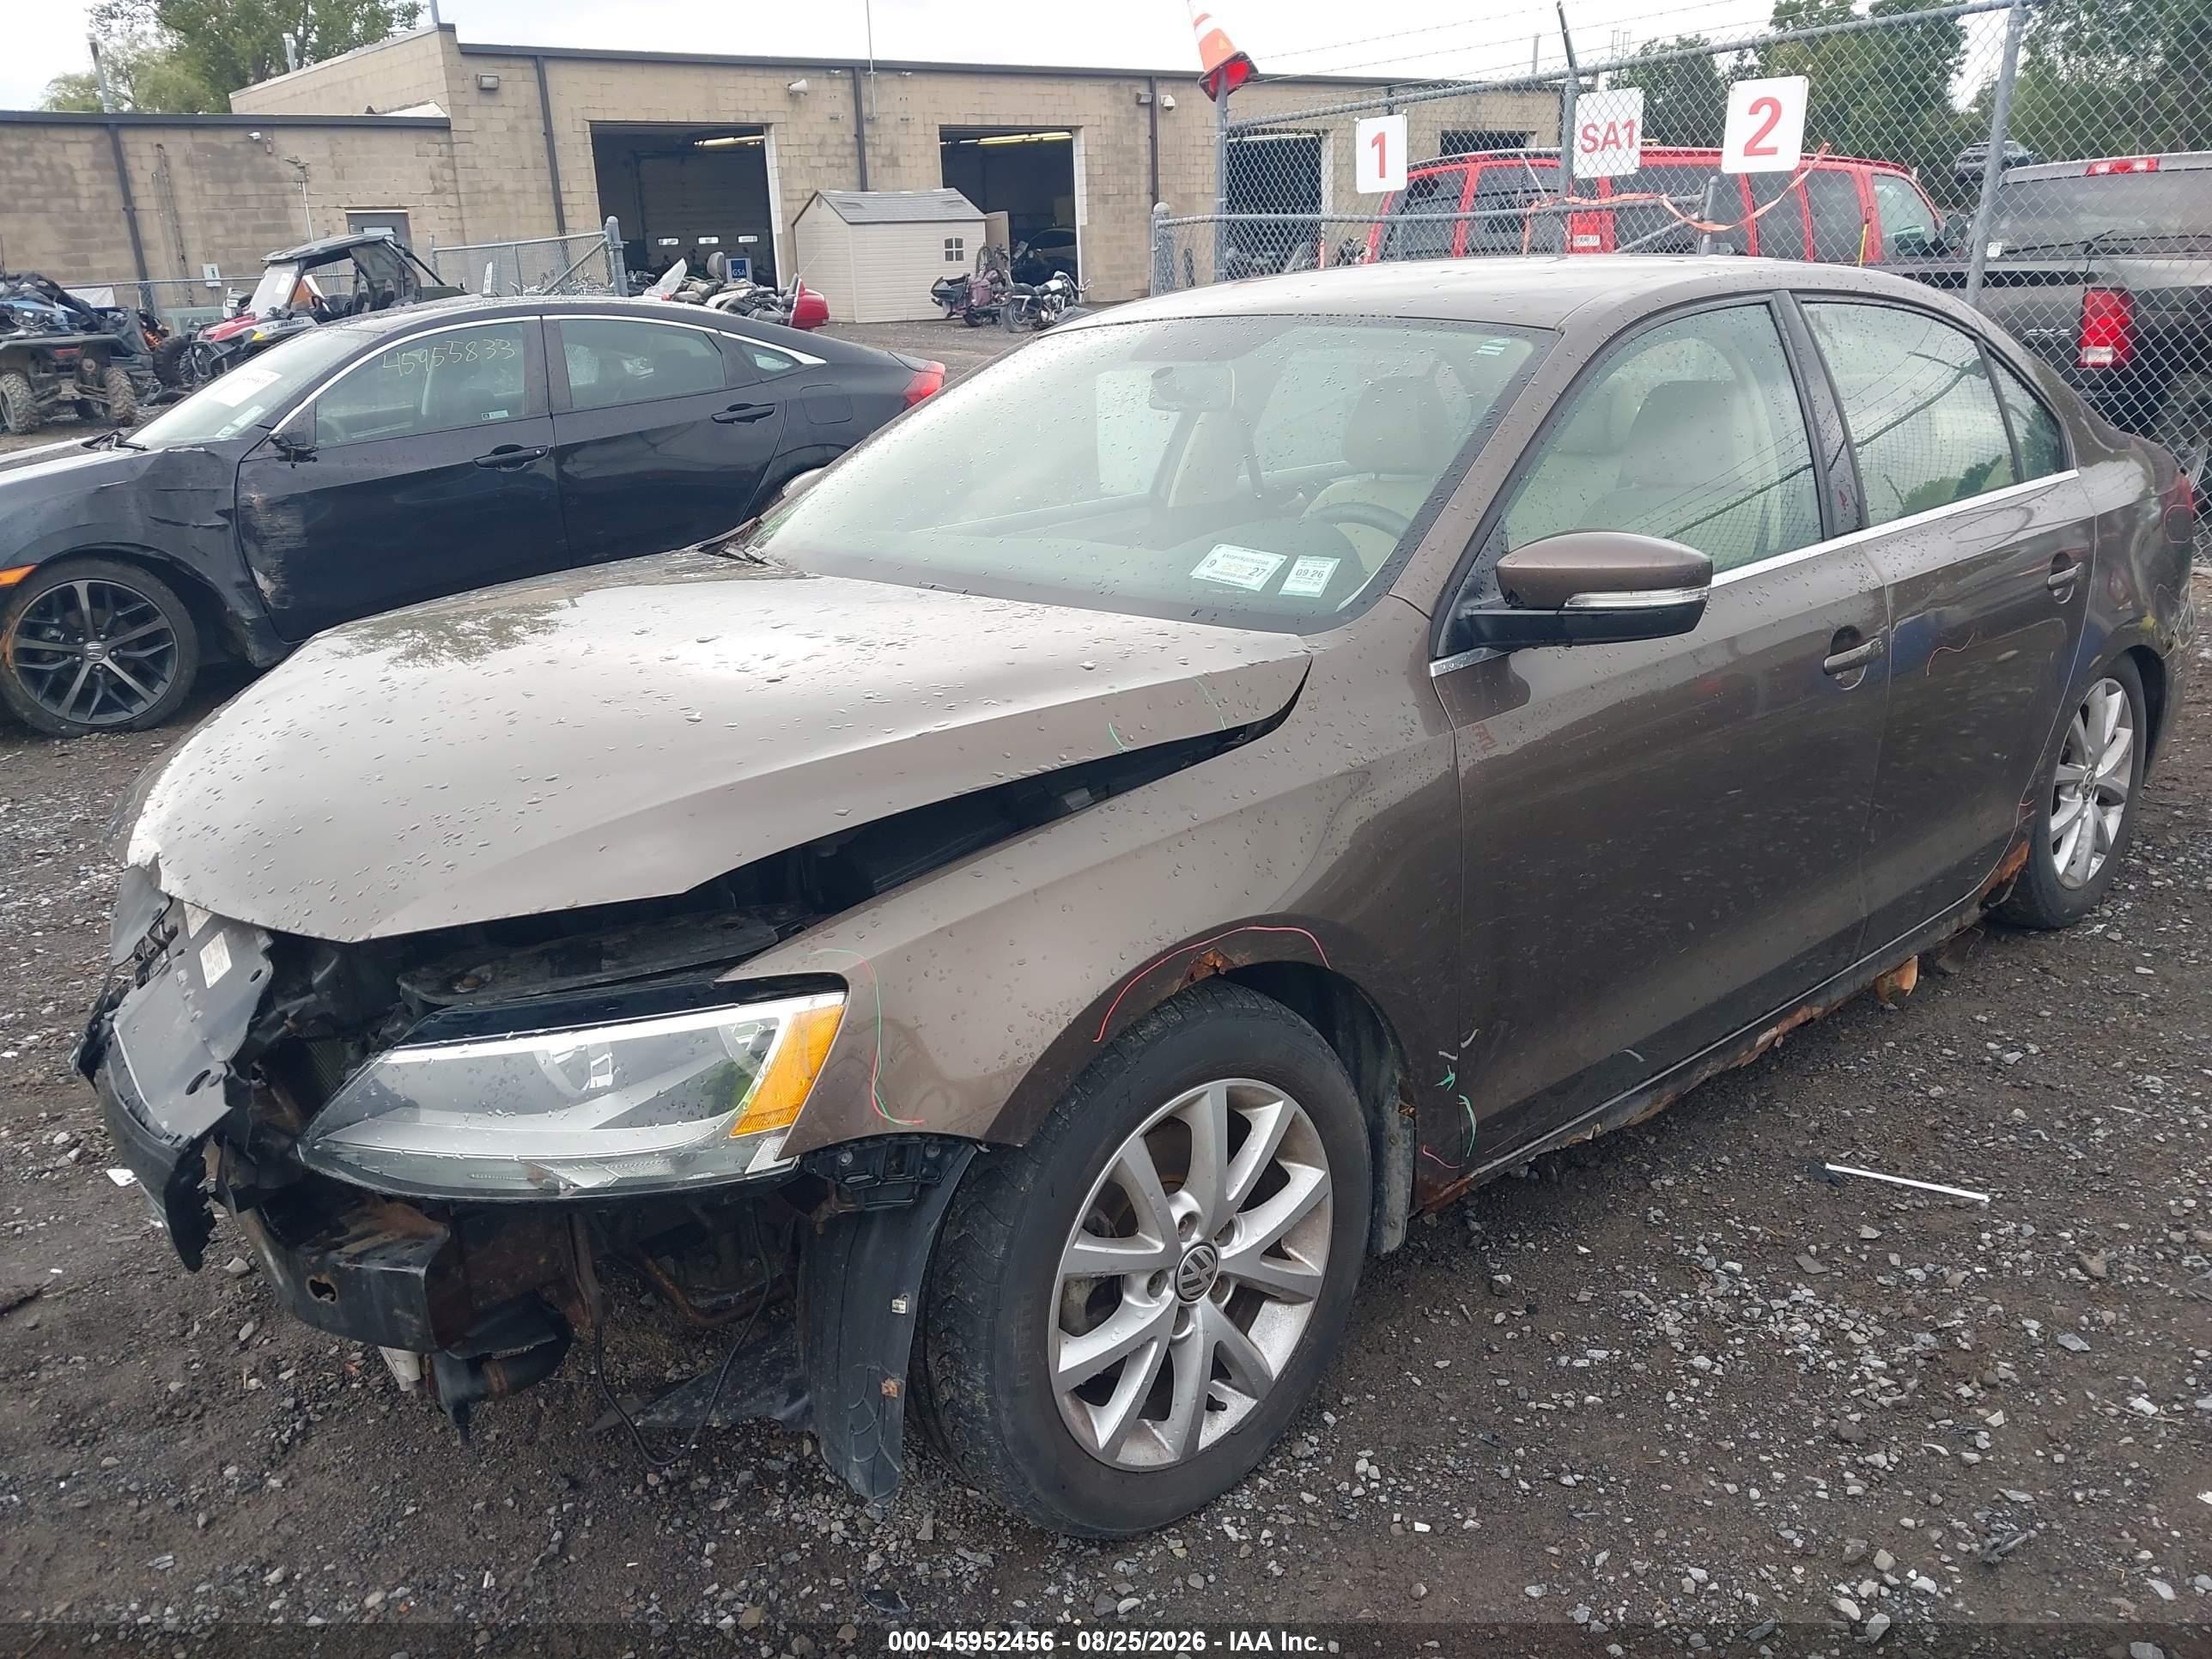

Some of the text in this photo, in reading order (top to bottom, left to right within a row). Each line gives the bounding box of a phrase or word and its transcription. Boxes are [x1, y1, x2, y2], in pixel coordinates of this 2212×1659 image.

[1579, 118, 1637, 155] SA1
[1743, 96, 1783, 157] 2
[1370, 131, 1387, 179] 1
[732, 268, 747, 276] GSA
[265, 319, 305, 331] TURBO
[382, 338, 515, 376] 45955833
[1206, 559, 1218, 568] 9
[1249, 567, 1267, 578] 27
[1295, 568, 1325, 579] 09 26
